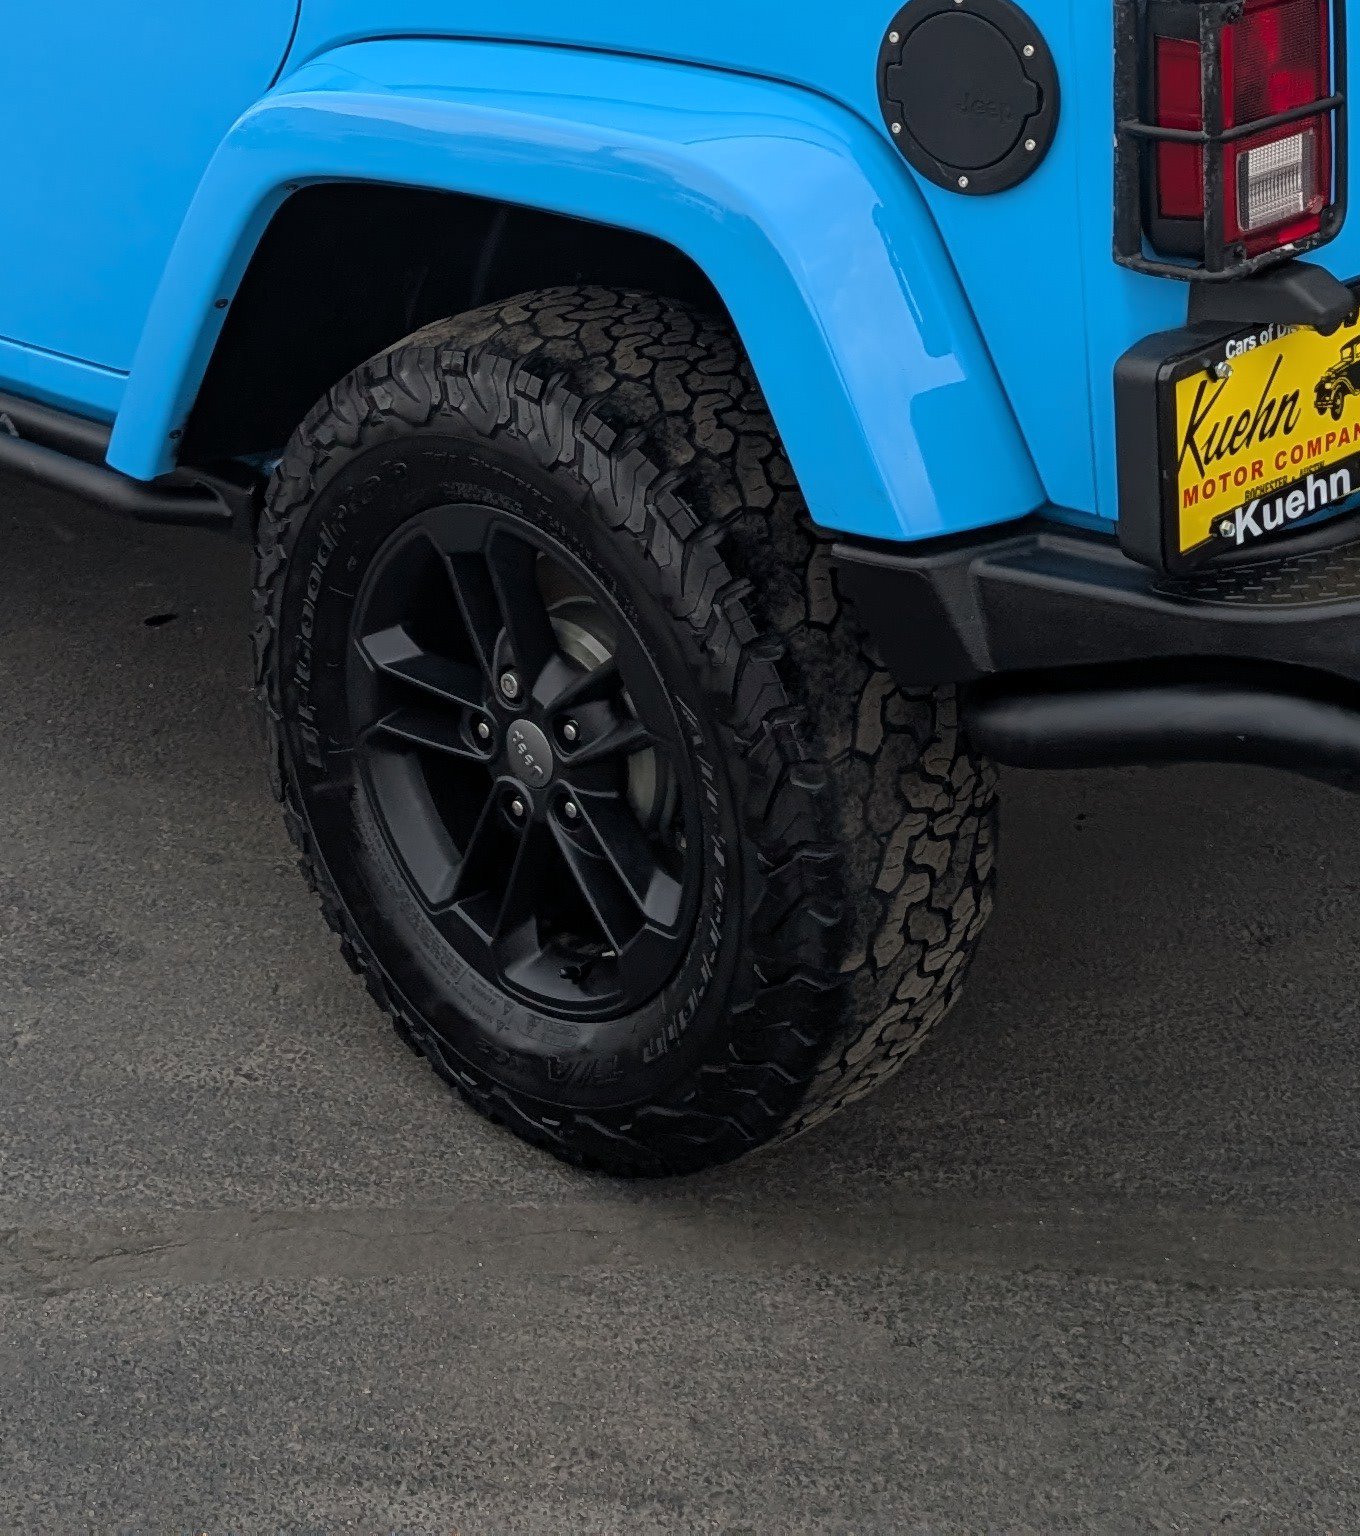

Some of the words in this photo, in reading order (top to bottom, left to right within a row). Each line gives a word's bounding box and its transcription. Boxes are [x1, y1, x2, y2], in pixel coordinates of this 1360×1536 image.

[1225, 335, 1256, 359] Cars
[1260, 323, 1274, 345] of
[1178, 354, 1301, 478] Kuehn
[1183, 459, 1264, 508] MOTOR
[1234, 467, 1351, 545] Kuehn
